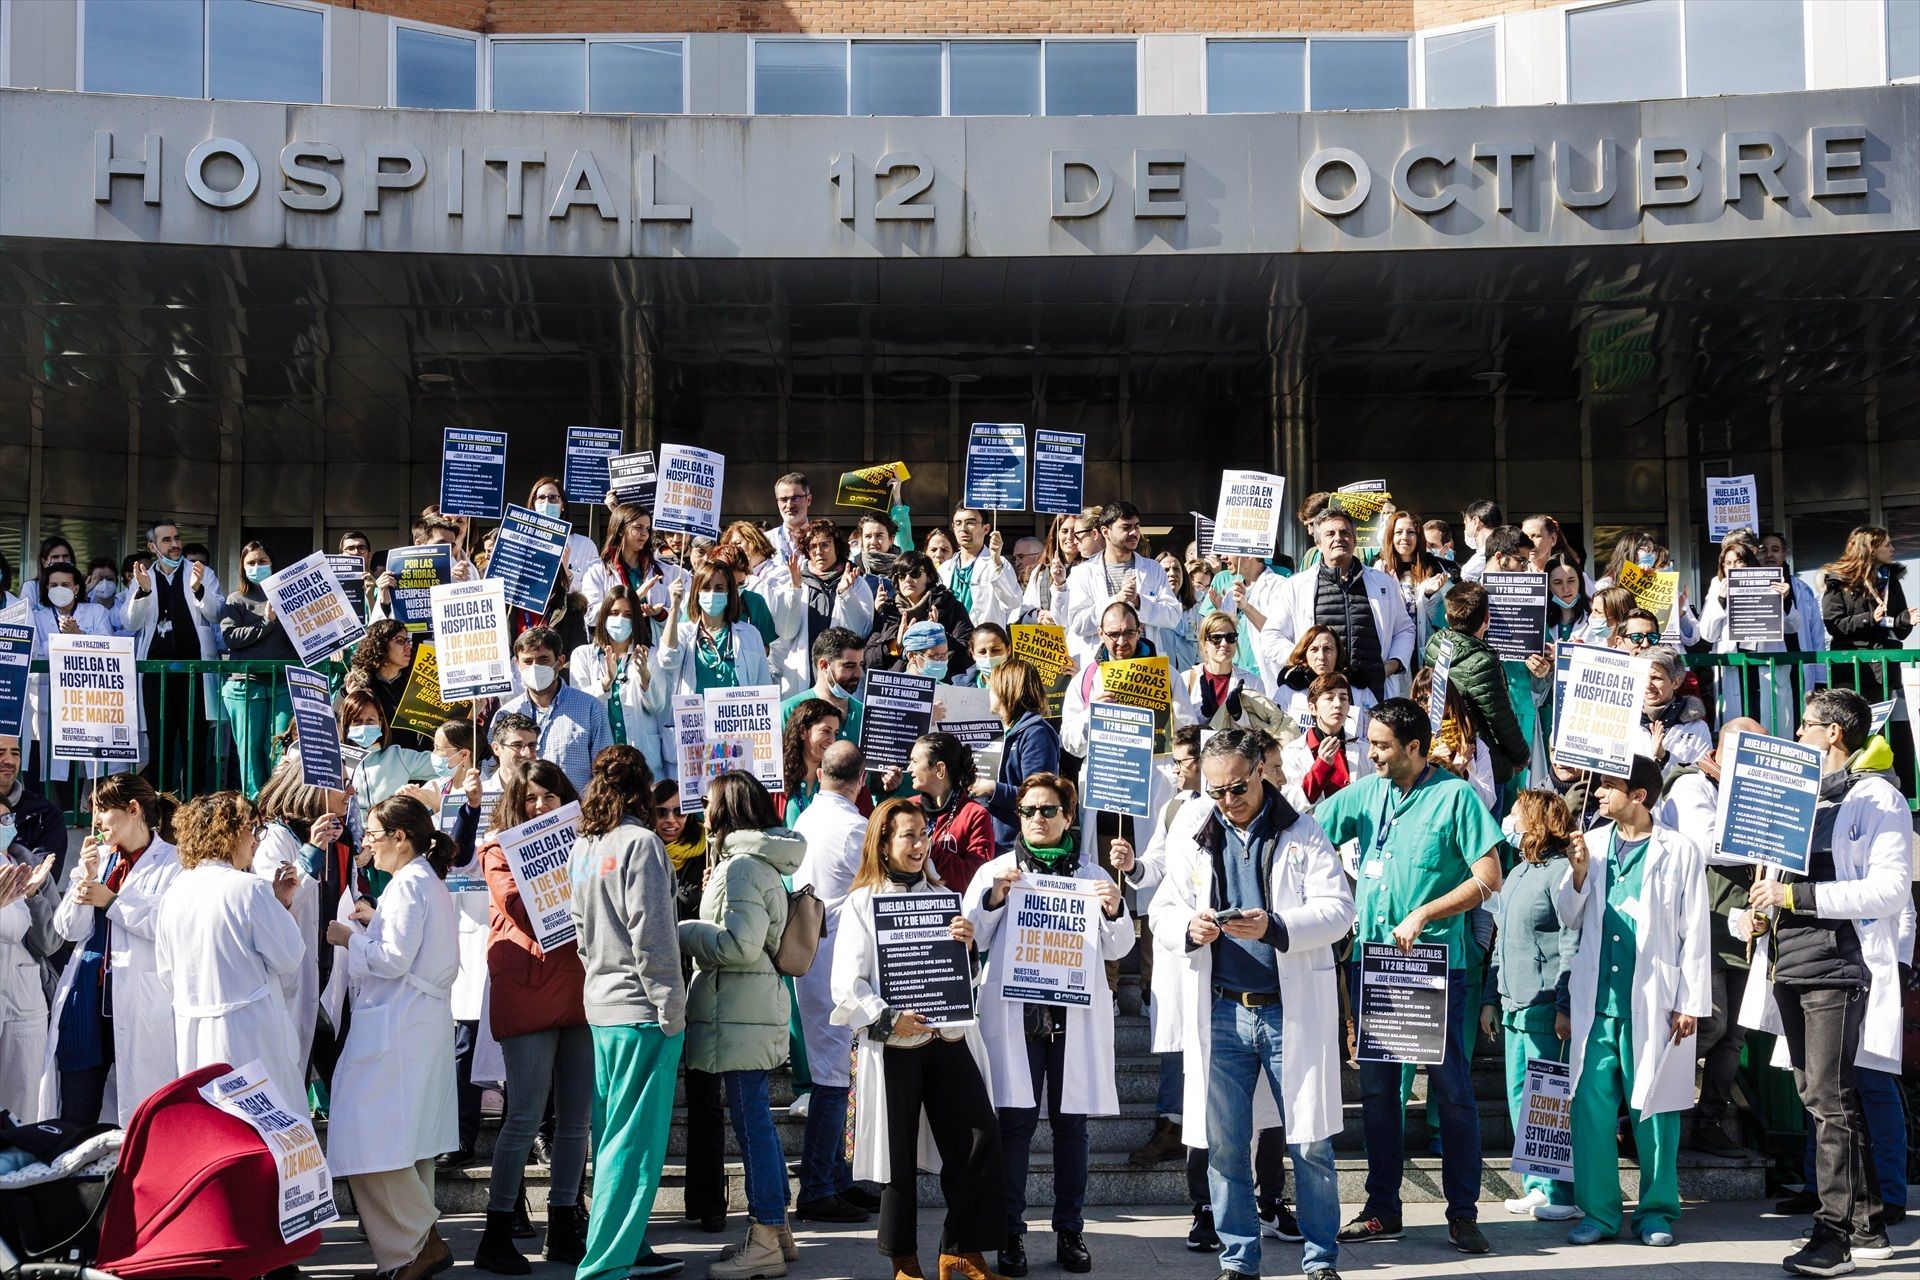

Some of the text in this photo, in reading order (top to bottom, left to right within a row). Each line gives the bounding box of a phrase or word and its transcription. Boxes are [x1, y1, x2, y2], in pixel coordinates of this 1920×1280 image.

[94, 124, 1868, 223] HOSPITAL 12 DE OCTUBRE
[671, 458, 713, 476] HUELGA EN
[666, 469, 715, 488] HOSPITALES
[667, 481, 713, 499] 1 DE MARZO
[1231, 485, 1272, 497] HUELGA EN
[1715, 487, 1748, 497] HUELGA EN
[664, 492, 670, 504] 2
[672, 494, 682, 505] DE
[683, 495, 712, 511] MARZO
[1226, 496, 1273, 508] HOSPITALES
[1713, 496, 1750, 506] HOSPITALES
[404, 558, 433, 569] POR LAS
[279, 563, 310, 582] #HAYRAZONES
[401, 568, 437, 579] 35 HORAS
[1487, 576, 1543, 584] HUELGA EN HOSPITALES
[278, 570, 323, 601] HUELGA EN
[395, 588, 430, 599] RECUPERE
[450, 585, 483, 596] #HAYRAZONES
[281, 581, 332, 614] HOSPITALES
[289, 593, 337, 625] 1 DE MARZO
[444, 599, 492, 619] HUELGA EN
[294, 604, 344, 638] 2 DE MARZO
[441, 614, 496, 635] HOSPITALES
[0, 629, 29, 639] SPITALES
[445, 630, 497, 650] 1 DE MARZO
[1017, 631, 1065, 654] 35 HORAS
[1035, 628, 1064, 644] POR LAS
[72, 640, 110, 650] #HAYRAZONES
[1014, 642, 1069, 665] SEMANALES
[64, 656, 120, 672] HUELGA EN
[444, 646, 498, 666] 2 DE MARZO
[1593, 655, 1629, 668] #HAYRAZONES
[1107, 668, 1167, 689] 35 HORAS
[1129, 663, 1165, 677] POR LAS
[60, 672, 124, 689] HOSPITALES
[872, 674, 931, 688] HUELGA EN HOSPITALES
[1581, 668, 1634, 691] HUELGA EN
[64, 689, 123, 706] 1 DE MARZO
[725, 690, 760, 699] #HAYRAZONES
[1104, 679, 1168, 700] SEMANALES
[1574, 684, 1635, 707] HOSPITALES
[61, 706, 124, 724] 2 DE MARZO
[718, 704, 768, 718] HUELGA EN
[1094, 707, 1149, 722] HUELGA EN HOSPITALES
[62, 727, 86, 735] NUESTRAS
[715, 718, 771, 732] HOSPITALES
[62, 735, 104, 743] REIVINDICACIONES
[1744, 738, 1817, 763] HUELGA EN HOSPITALES
[1754, 755, 1803, 774] 1 Y 2 DE MARZO
[1763, 771, 1806, 787] REIVINDICAMOS?
[522, 815, 561, 837] #HAYRAZONES
[519, 826, 576, 863] HUELGA EN
[1036, 879, 1077, 891] #HAYRAZONES
[879, 899, 955, 912] HUELGA EN HOSPITALES
[1024, 894, 1084, 915] HUELGA EN
[893, 914, 943, 928] 1 Y 2 DE MARZO
[1018, 911, 1087, 932] HOSPITALES
[905, 929, 949, 939] REIVINDICAMOS?
[1020, 928, 1084, 950] 1 DE MARZO
[1015, 945, 1083, 967] 2 DE MARZO
[1369, 947, 1392, 956] HUELGA
[1404, 949, 1442, 959] OSPITALES
[1014, 967, 1040, 976] NUESTRAS
[1380, 961, 1428, 972] 1 Y 2 DE MARZO
[1013, 975, 1058, 986] REIVINDICACIONES
[1389, 975, 1432, 985] REIVINDICAMOS?
[1528, 1110, 1571, 1130] DE MARZO
[1525, 1142, 1571, 1162] HUELGA EN
